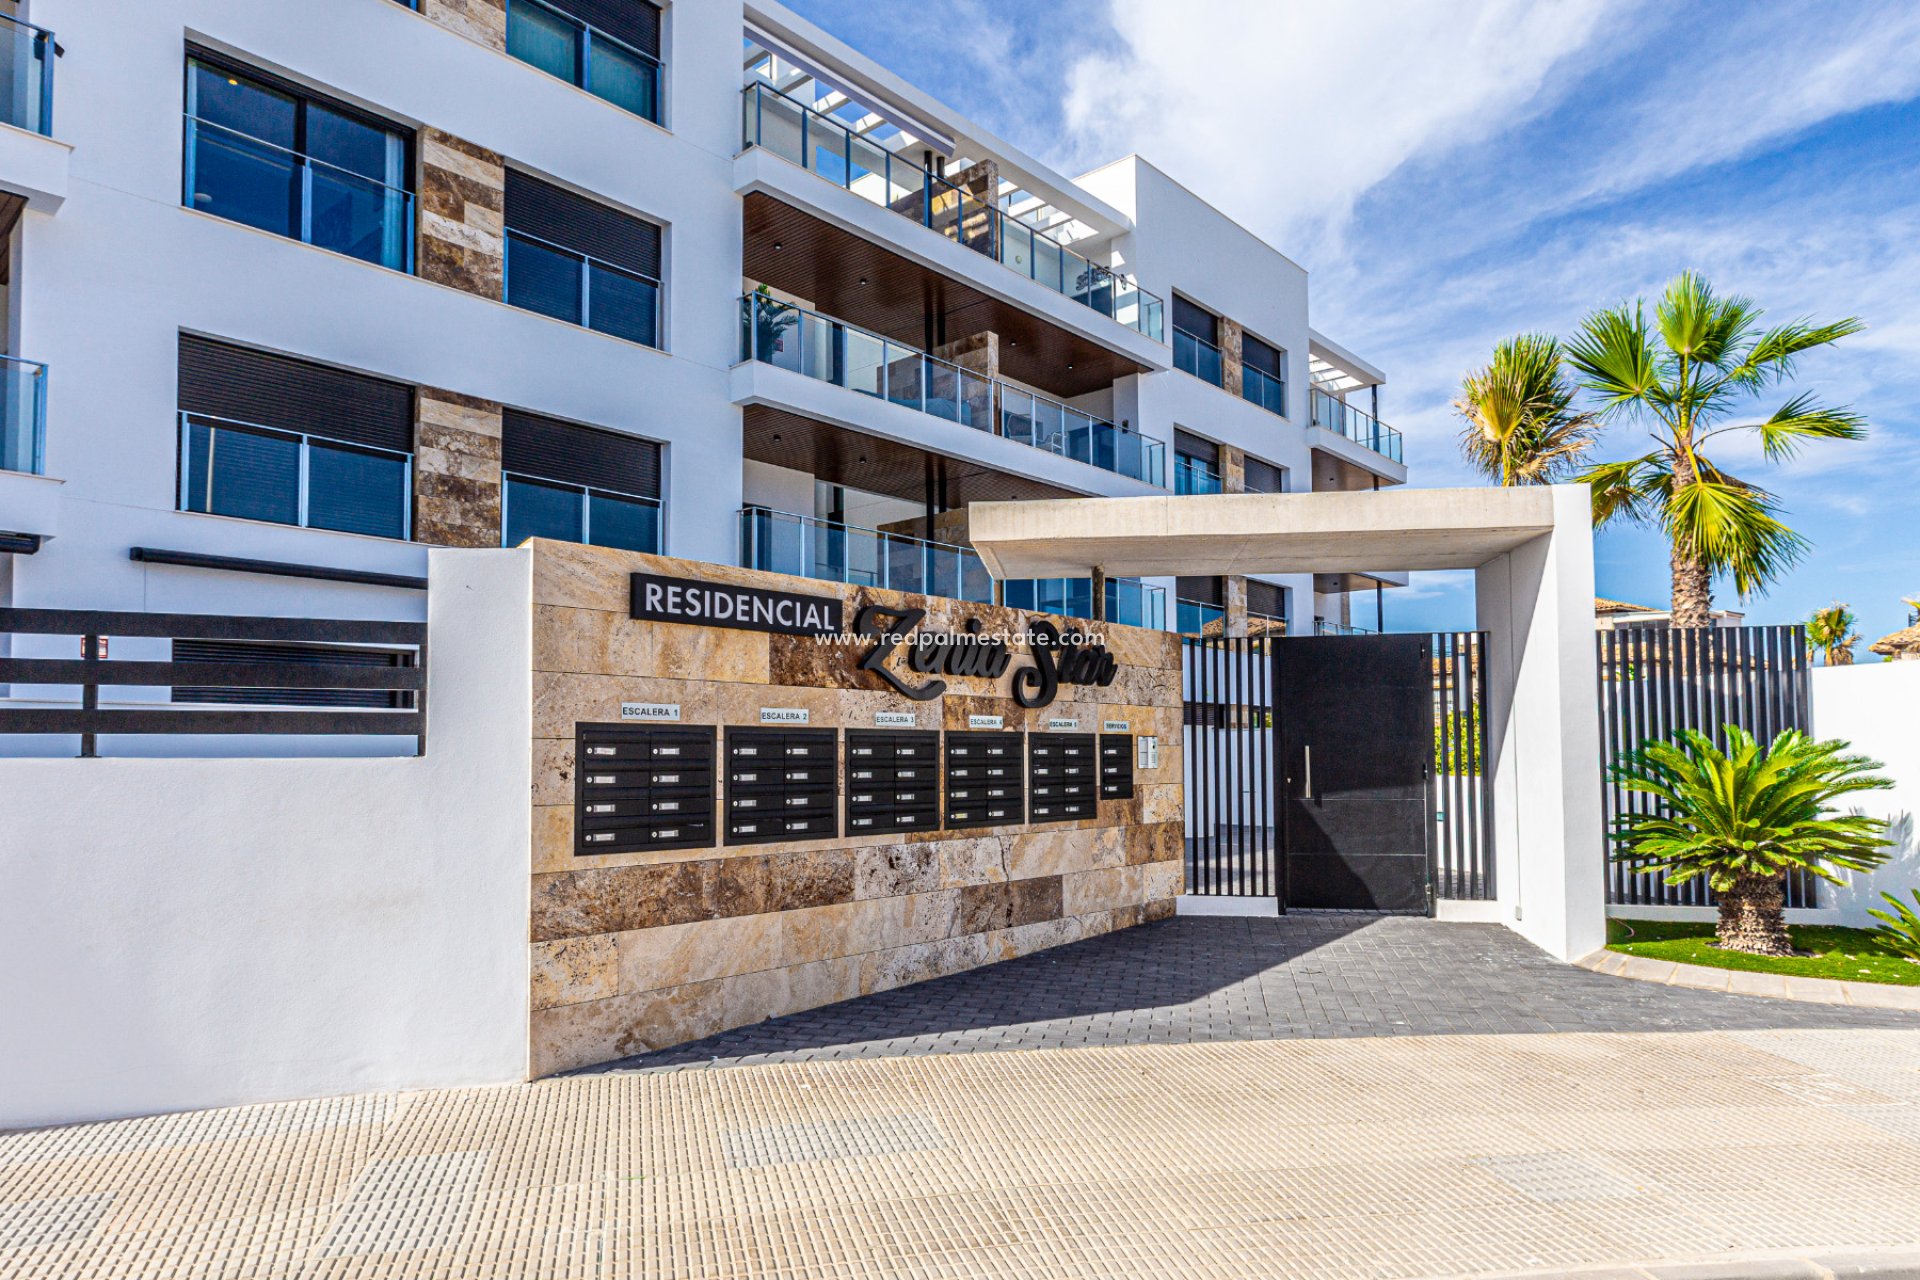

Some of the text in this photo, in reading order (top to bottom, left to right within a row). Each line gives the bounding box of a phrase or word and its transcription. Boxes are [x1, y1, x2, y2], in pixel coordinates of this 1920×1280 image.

[645, 583, 835, 630] RESIDENCIAL
[622, 706, 679, 718] ESCALERA 1
[761, 711, 808, 720] ESCALERA 2
